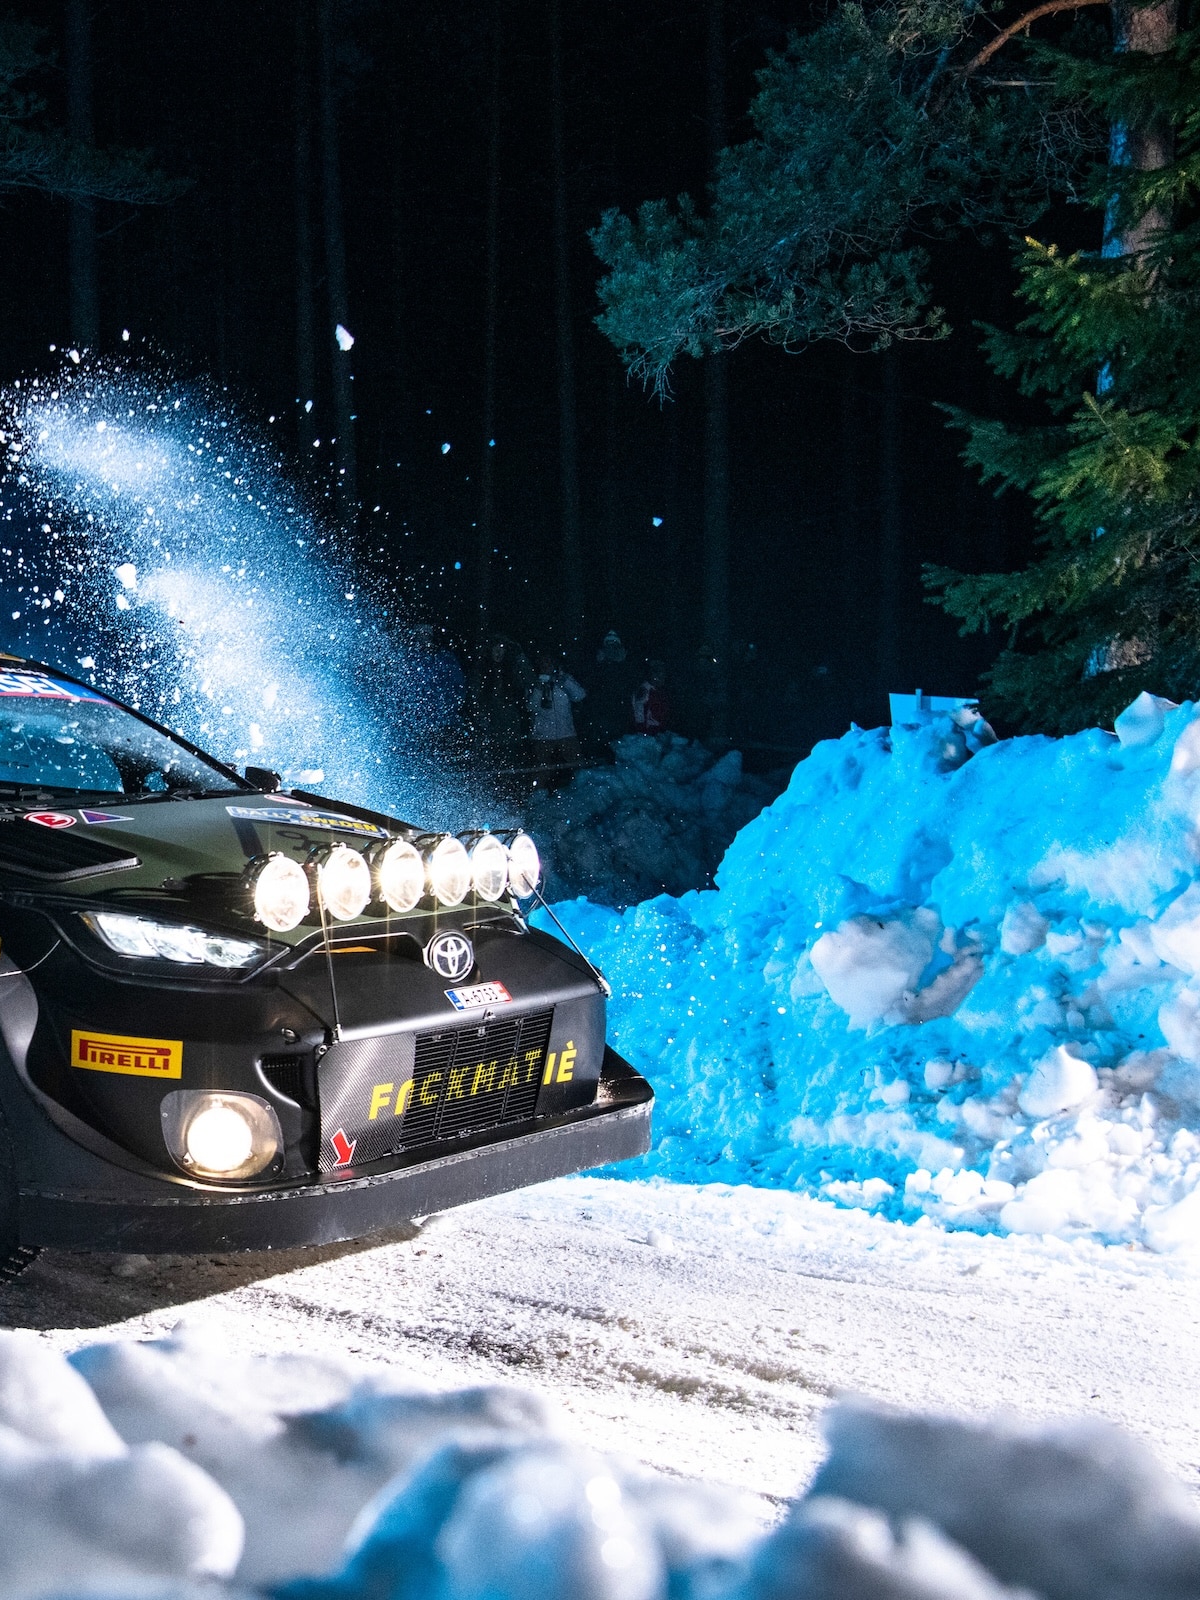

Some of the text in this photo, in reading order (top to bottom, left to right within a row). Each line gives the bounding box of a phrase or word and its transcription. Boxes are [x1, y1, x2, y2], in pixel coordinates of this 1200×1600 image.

[301, 815, 379, 832] SWEDEN
[461, 987, 498, 1005] A-6753
[79, 1038, 171, 1071] PIRELLI
